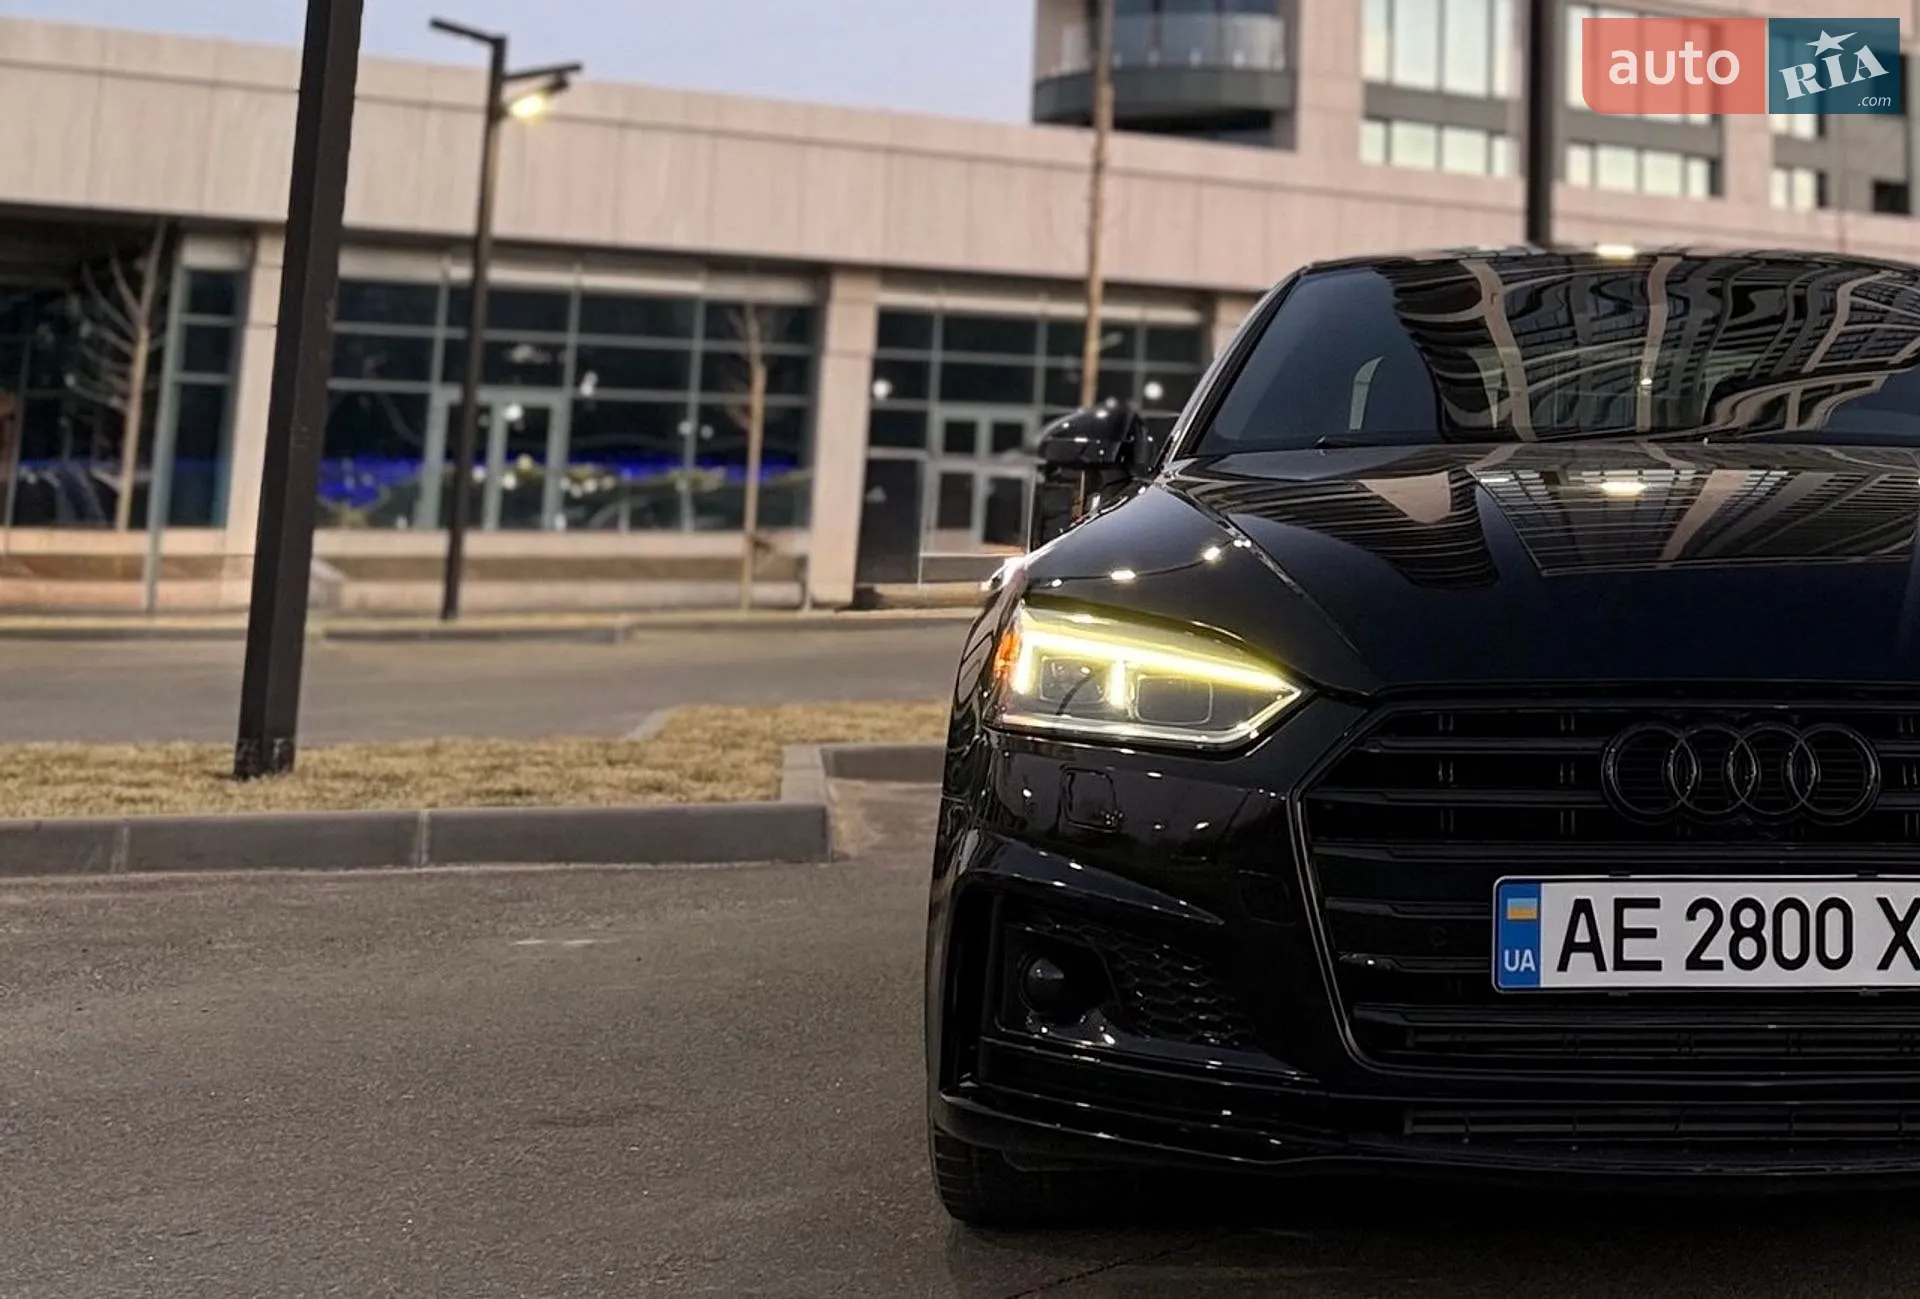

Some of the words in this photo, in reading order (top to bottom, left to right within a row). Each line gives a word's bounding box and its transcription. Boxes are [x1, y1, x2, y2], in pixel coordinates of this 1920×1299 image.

[1557, 896, 1662, 973] AE
[1685, 896, 1854, 971] 2800
[1876, 896, 1920, 971] X
[1504, 949, 1536, 972] UA
